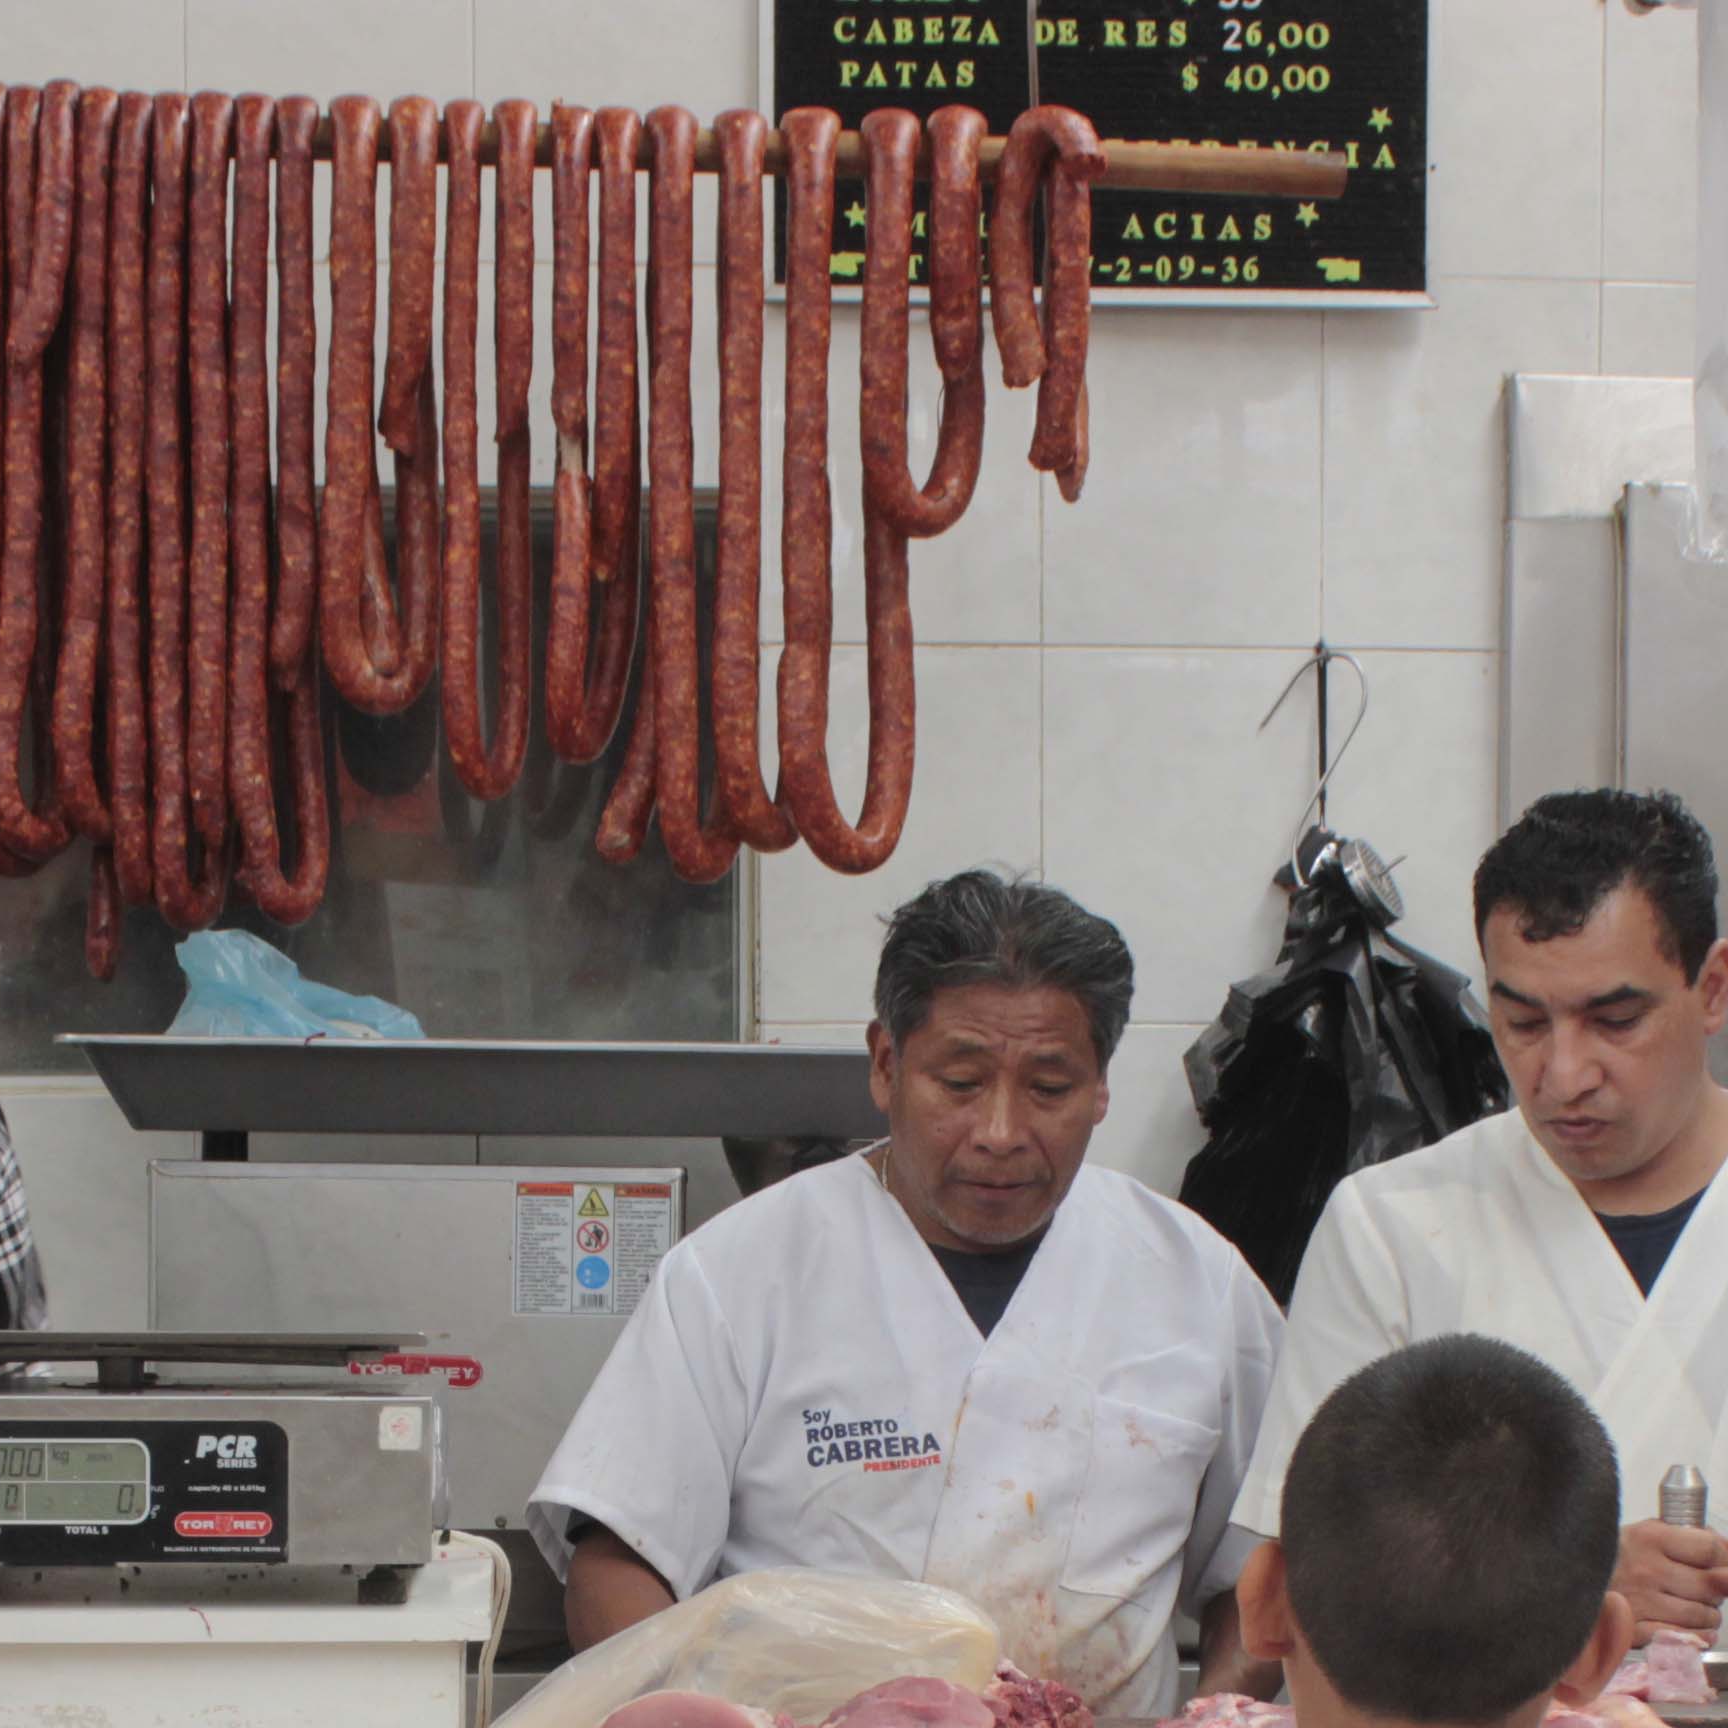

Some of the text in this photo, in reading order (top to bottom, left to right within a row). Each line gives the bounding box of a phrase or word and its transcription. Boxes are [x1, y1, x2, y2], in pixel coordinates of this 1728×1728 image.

[833, 16, 1330, 56] CABEZA DE RES 26,00
[840, 60, 1330, 100] PATAS $ 40,00
[1122, 213, 1273, 241] ACIAS
[802, 1409, 831, 1425] Soy
[806, 1419, 898, 1445] ROBERTO
[195, 1435, 258, 1458] PCR
[807, 1433, 940, 1468] CABRERA
[216, 1458, 257, 1469] SERIES
[863, 1454, 941, 1472] PRESIDENTE
[65, 1525, 100, 1535] TOTAL
[181, 1520, 266, 1530] TOR REY
